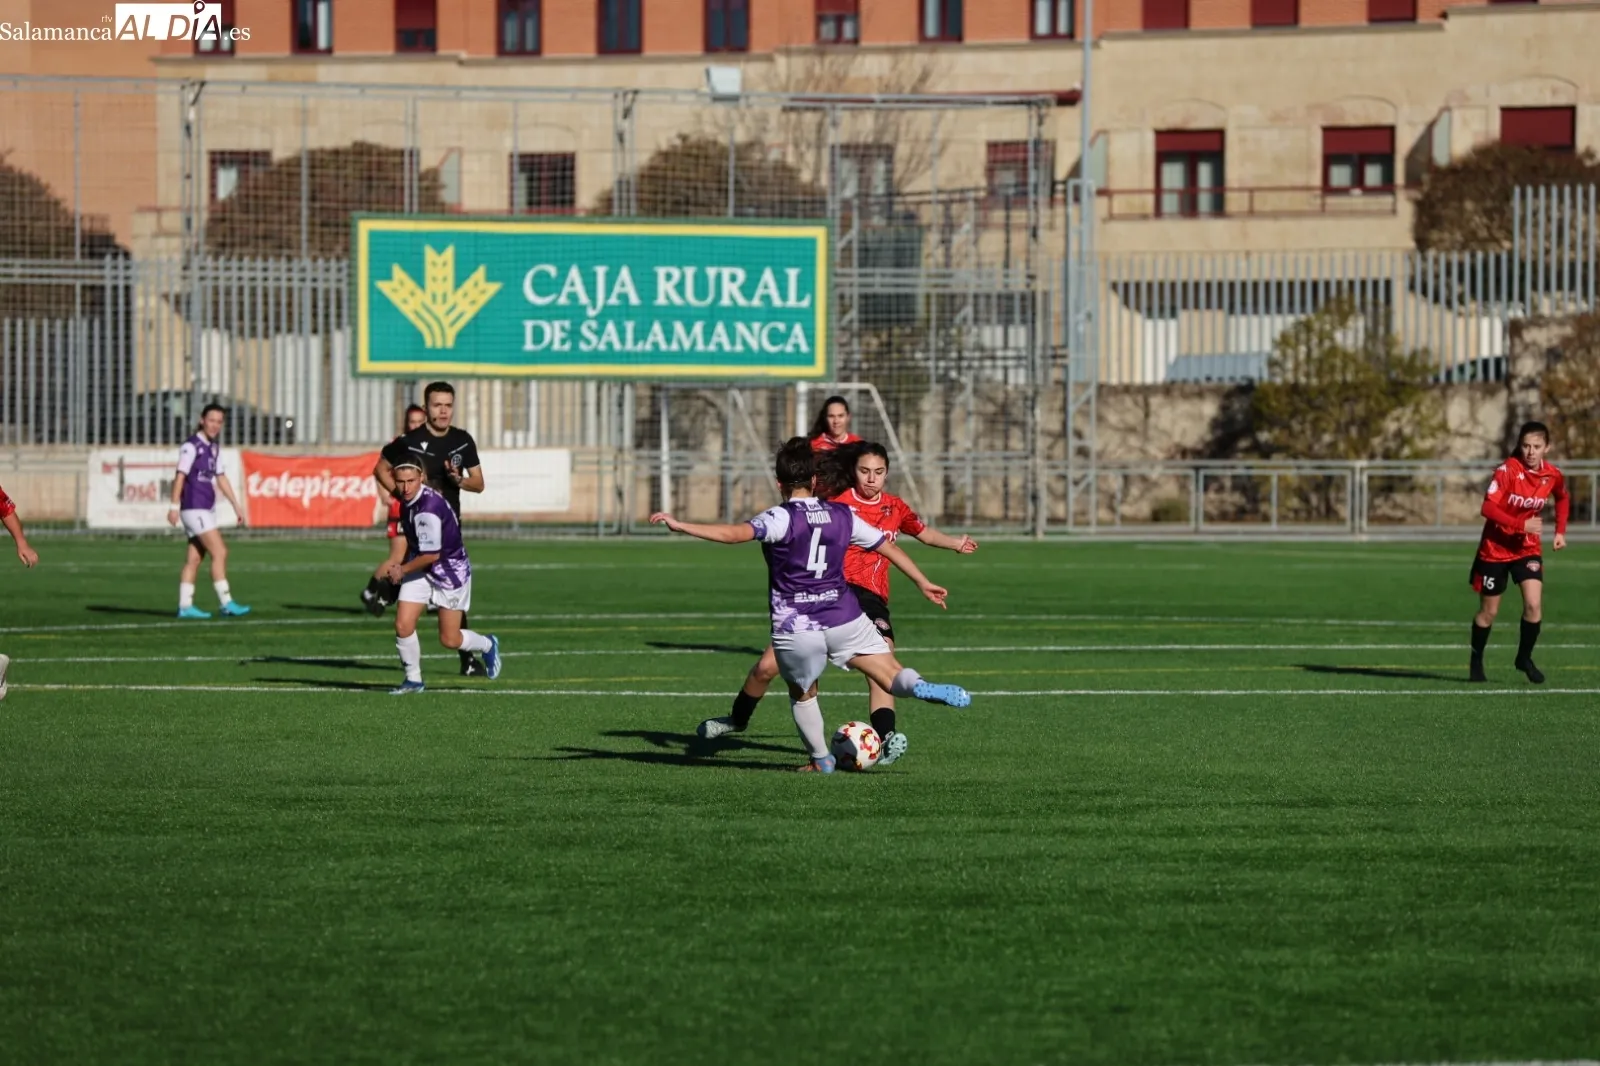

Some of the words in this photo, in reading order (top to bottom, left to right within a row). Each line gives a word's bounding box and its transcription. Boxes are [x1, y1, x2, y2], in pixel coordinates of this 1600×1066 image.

[522, 264, 640, 317] CAJA
[654, 265, 811, 309] RURAL
[523, 319, 571, 353] DE
[580, 319, 811, 354] SALAMANCA
[248, 469, 377, 508] telepizza
[806, 527, 828, 579] 4
